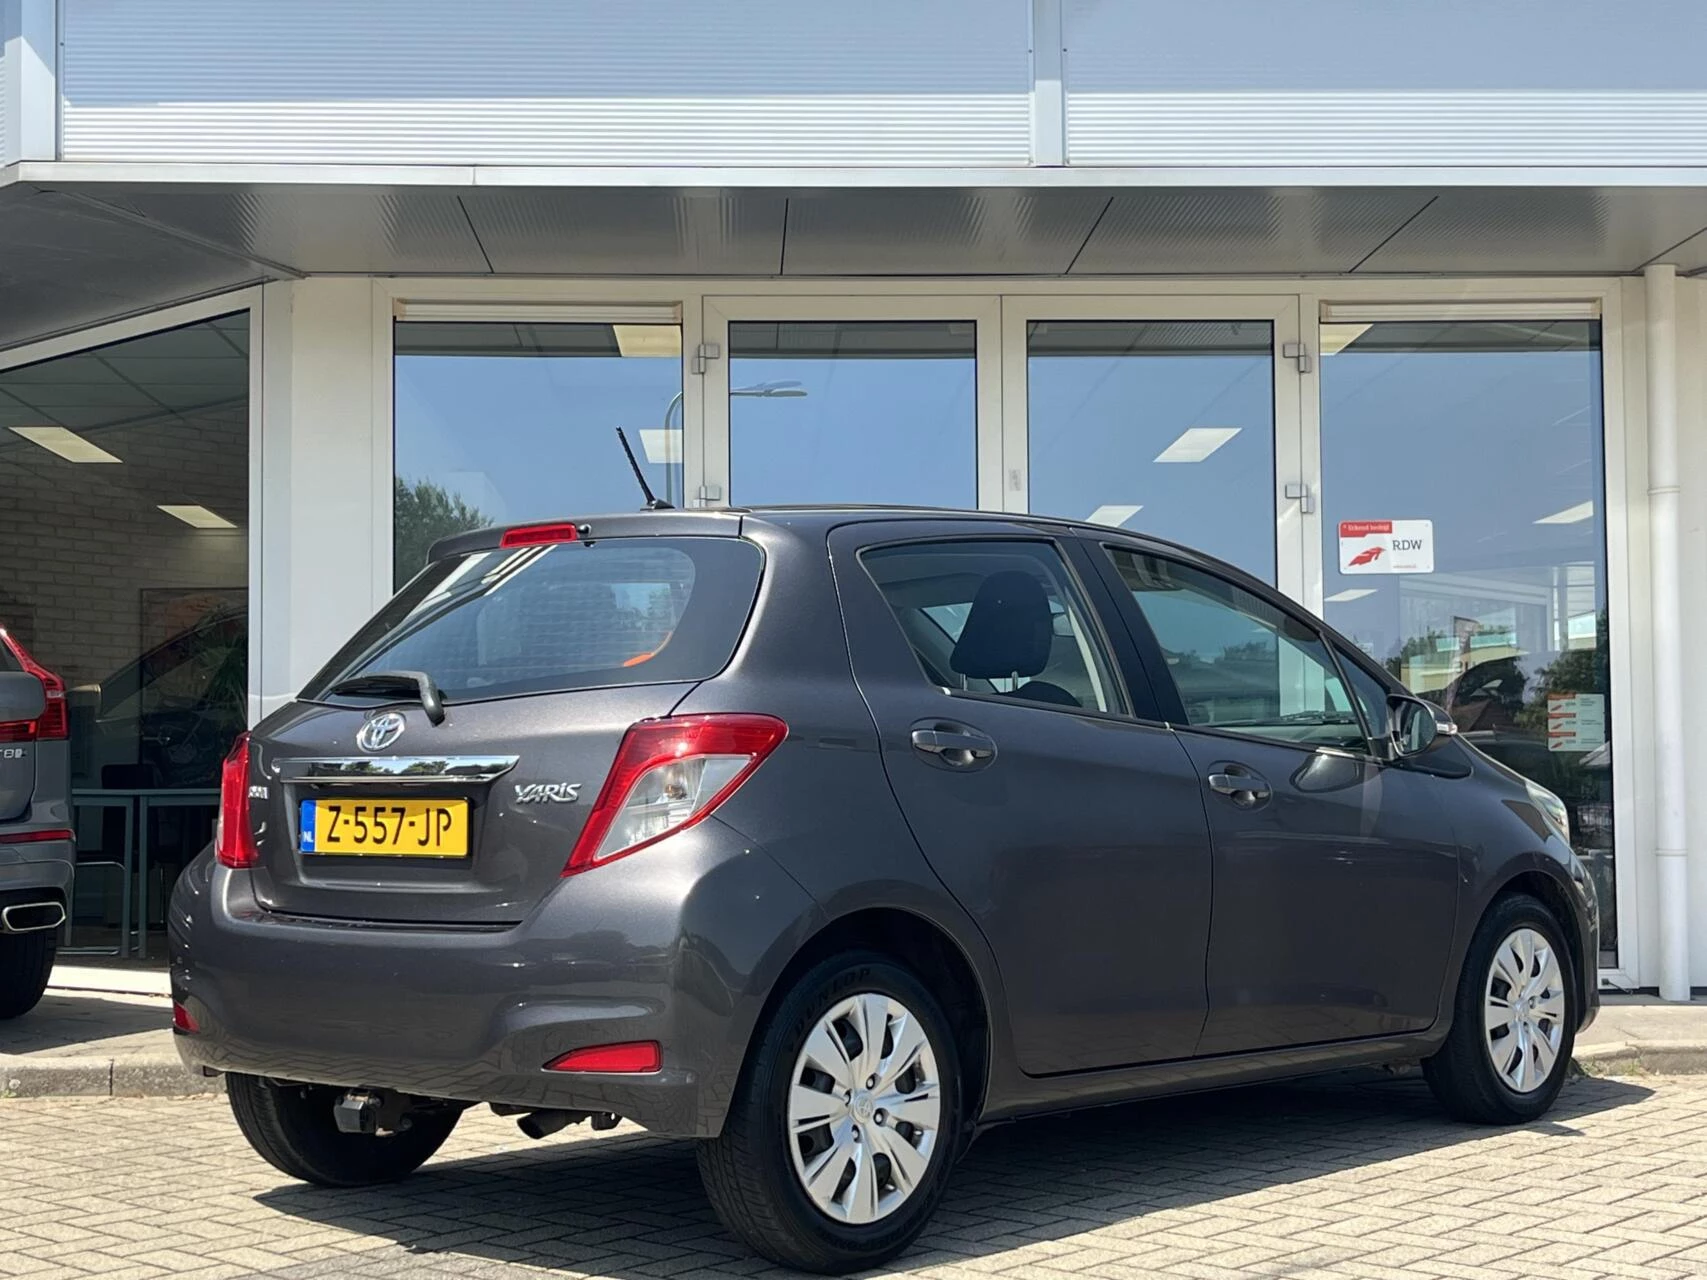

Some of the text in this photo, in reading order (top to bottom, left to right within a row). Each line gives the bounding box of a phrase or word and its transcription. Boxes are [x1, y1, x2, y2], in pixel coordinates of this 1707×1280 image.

[1392, 539, 1422, 551] RDW
[326, 804, 452, 847] Z-557-JP
[303, 831, 313, 843] NL
